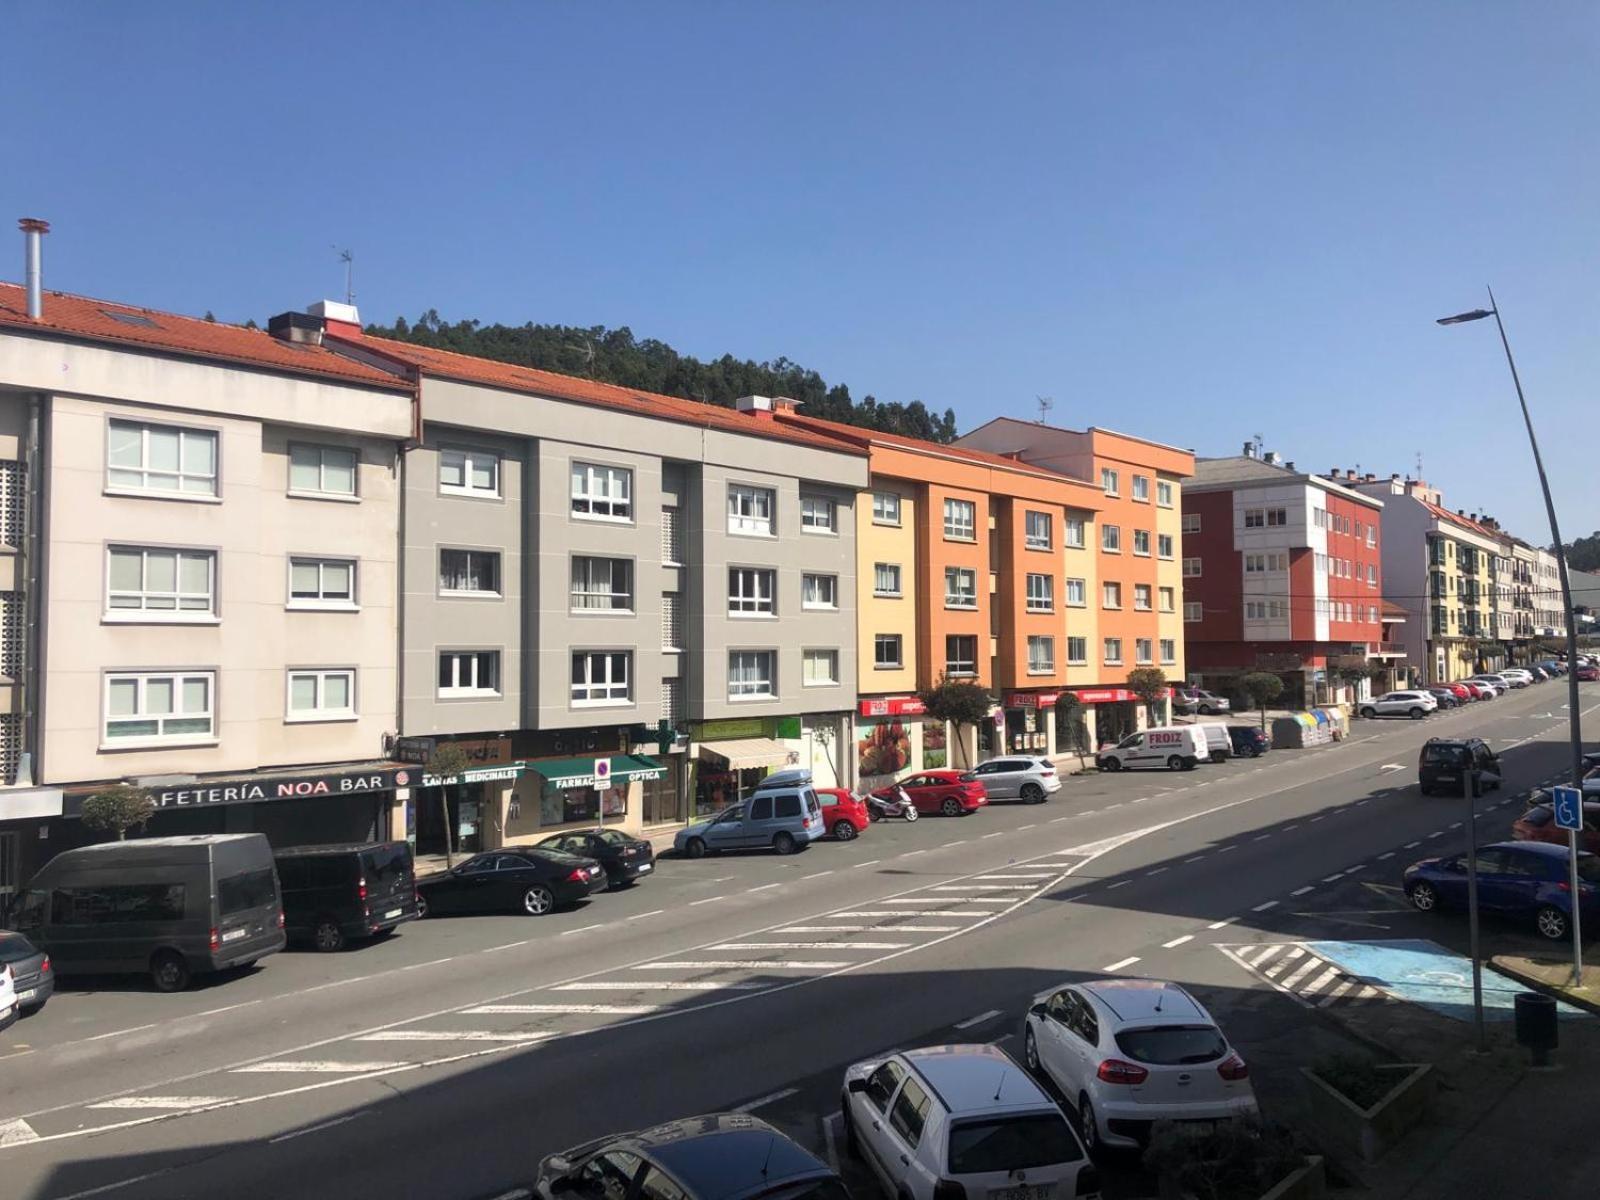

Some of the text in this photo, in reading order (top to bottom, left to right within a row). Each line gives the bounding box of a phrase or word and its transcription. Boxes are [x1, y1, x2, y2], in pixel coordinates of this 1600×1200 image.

[1149, 732, 1182, 745] FROIZ
[465, 770, 517, 783] MEDICINALES
[556, 777, 595, 789] FARMAC
[145, 776, 382, 807] AFETERÍA NOA BAR
